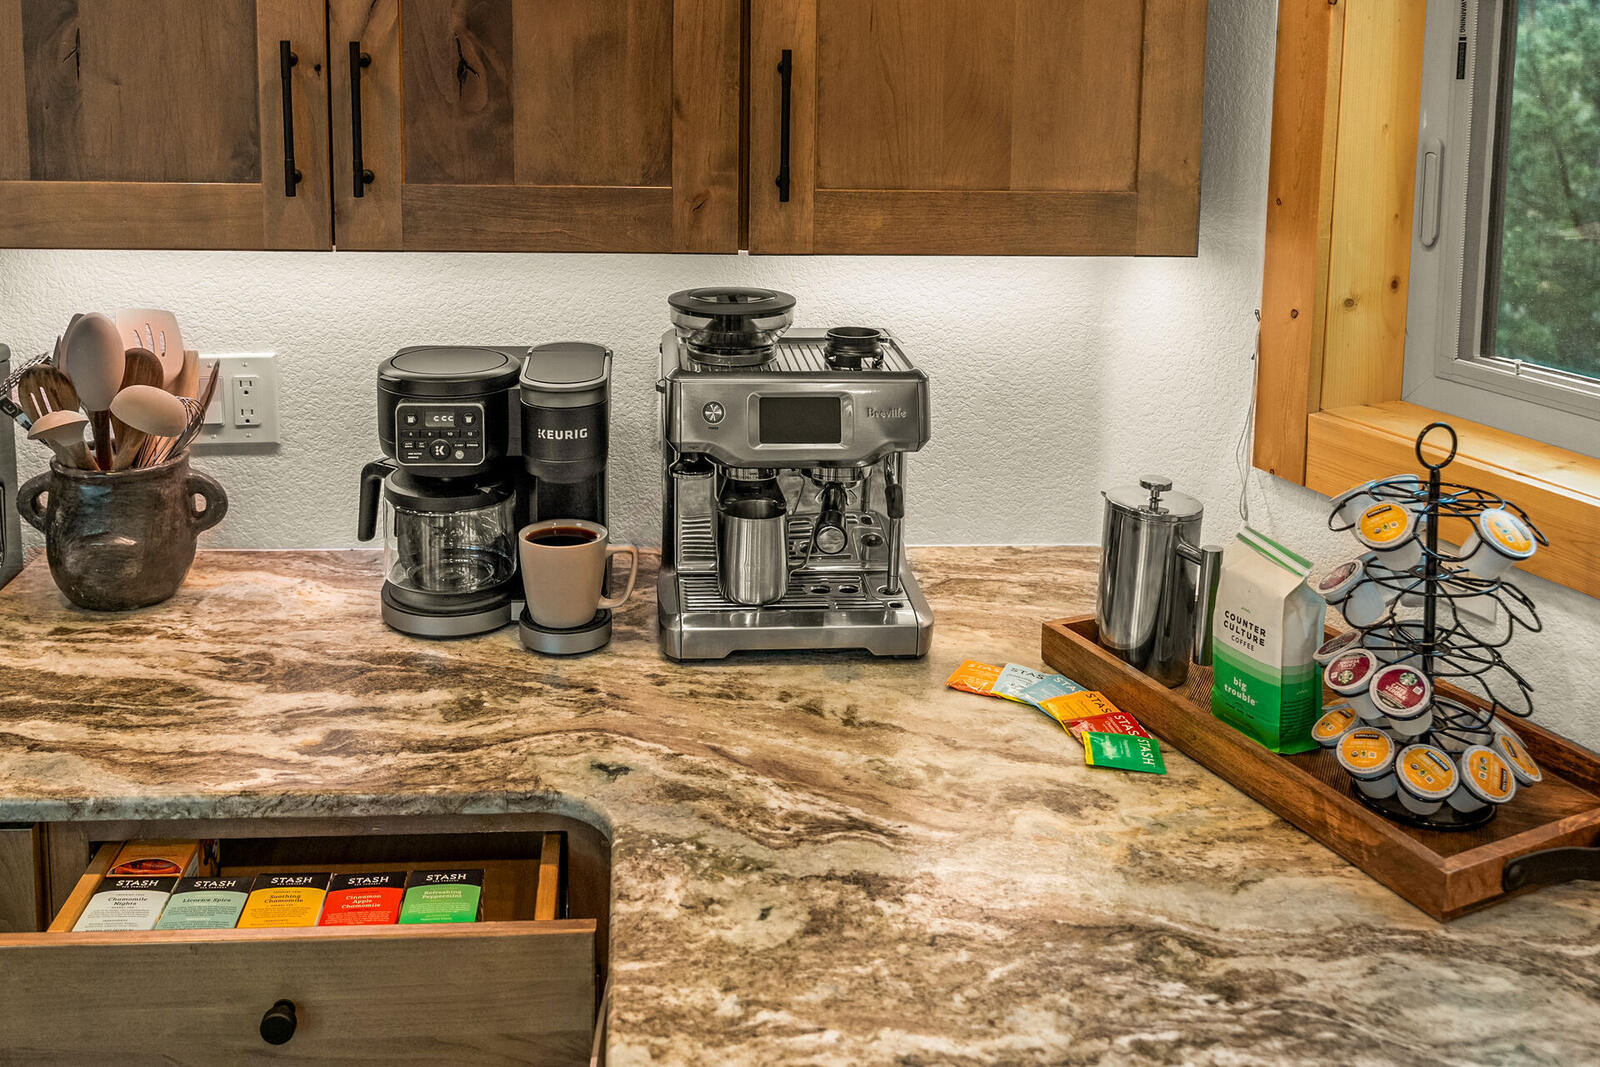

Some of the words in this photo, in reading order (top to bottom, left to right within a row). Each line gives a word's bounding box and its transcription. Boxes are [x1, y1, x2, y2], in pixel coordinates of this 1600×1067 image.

[866, 407, 907, 419] Breville
[538, 428, 588, 440] KEURIG
[1224, 610, 1266, 637] COUNTER
[1223, 620, 1265, 647] CULTURE
[1231, 635, 1254, 651] COFFEE
[968, 663, 1000, 673] STAS
[1010, 667, 1045, 680] STAS
[1053, 677, 1076, 691] STA
[1233, 676, 1247, 692] big
[1085, 692, 1112, 713] STAS
[1224, 684, 1256, 706] trouble
[1114, 714, 1139, 736] STAS
[1137, 738, 1155, 766] STASH
[116, 879, 159, 887] STASH
[348, 876, 389, 884] STASH
[426, 873, 467, 881] STASH
